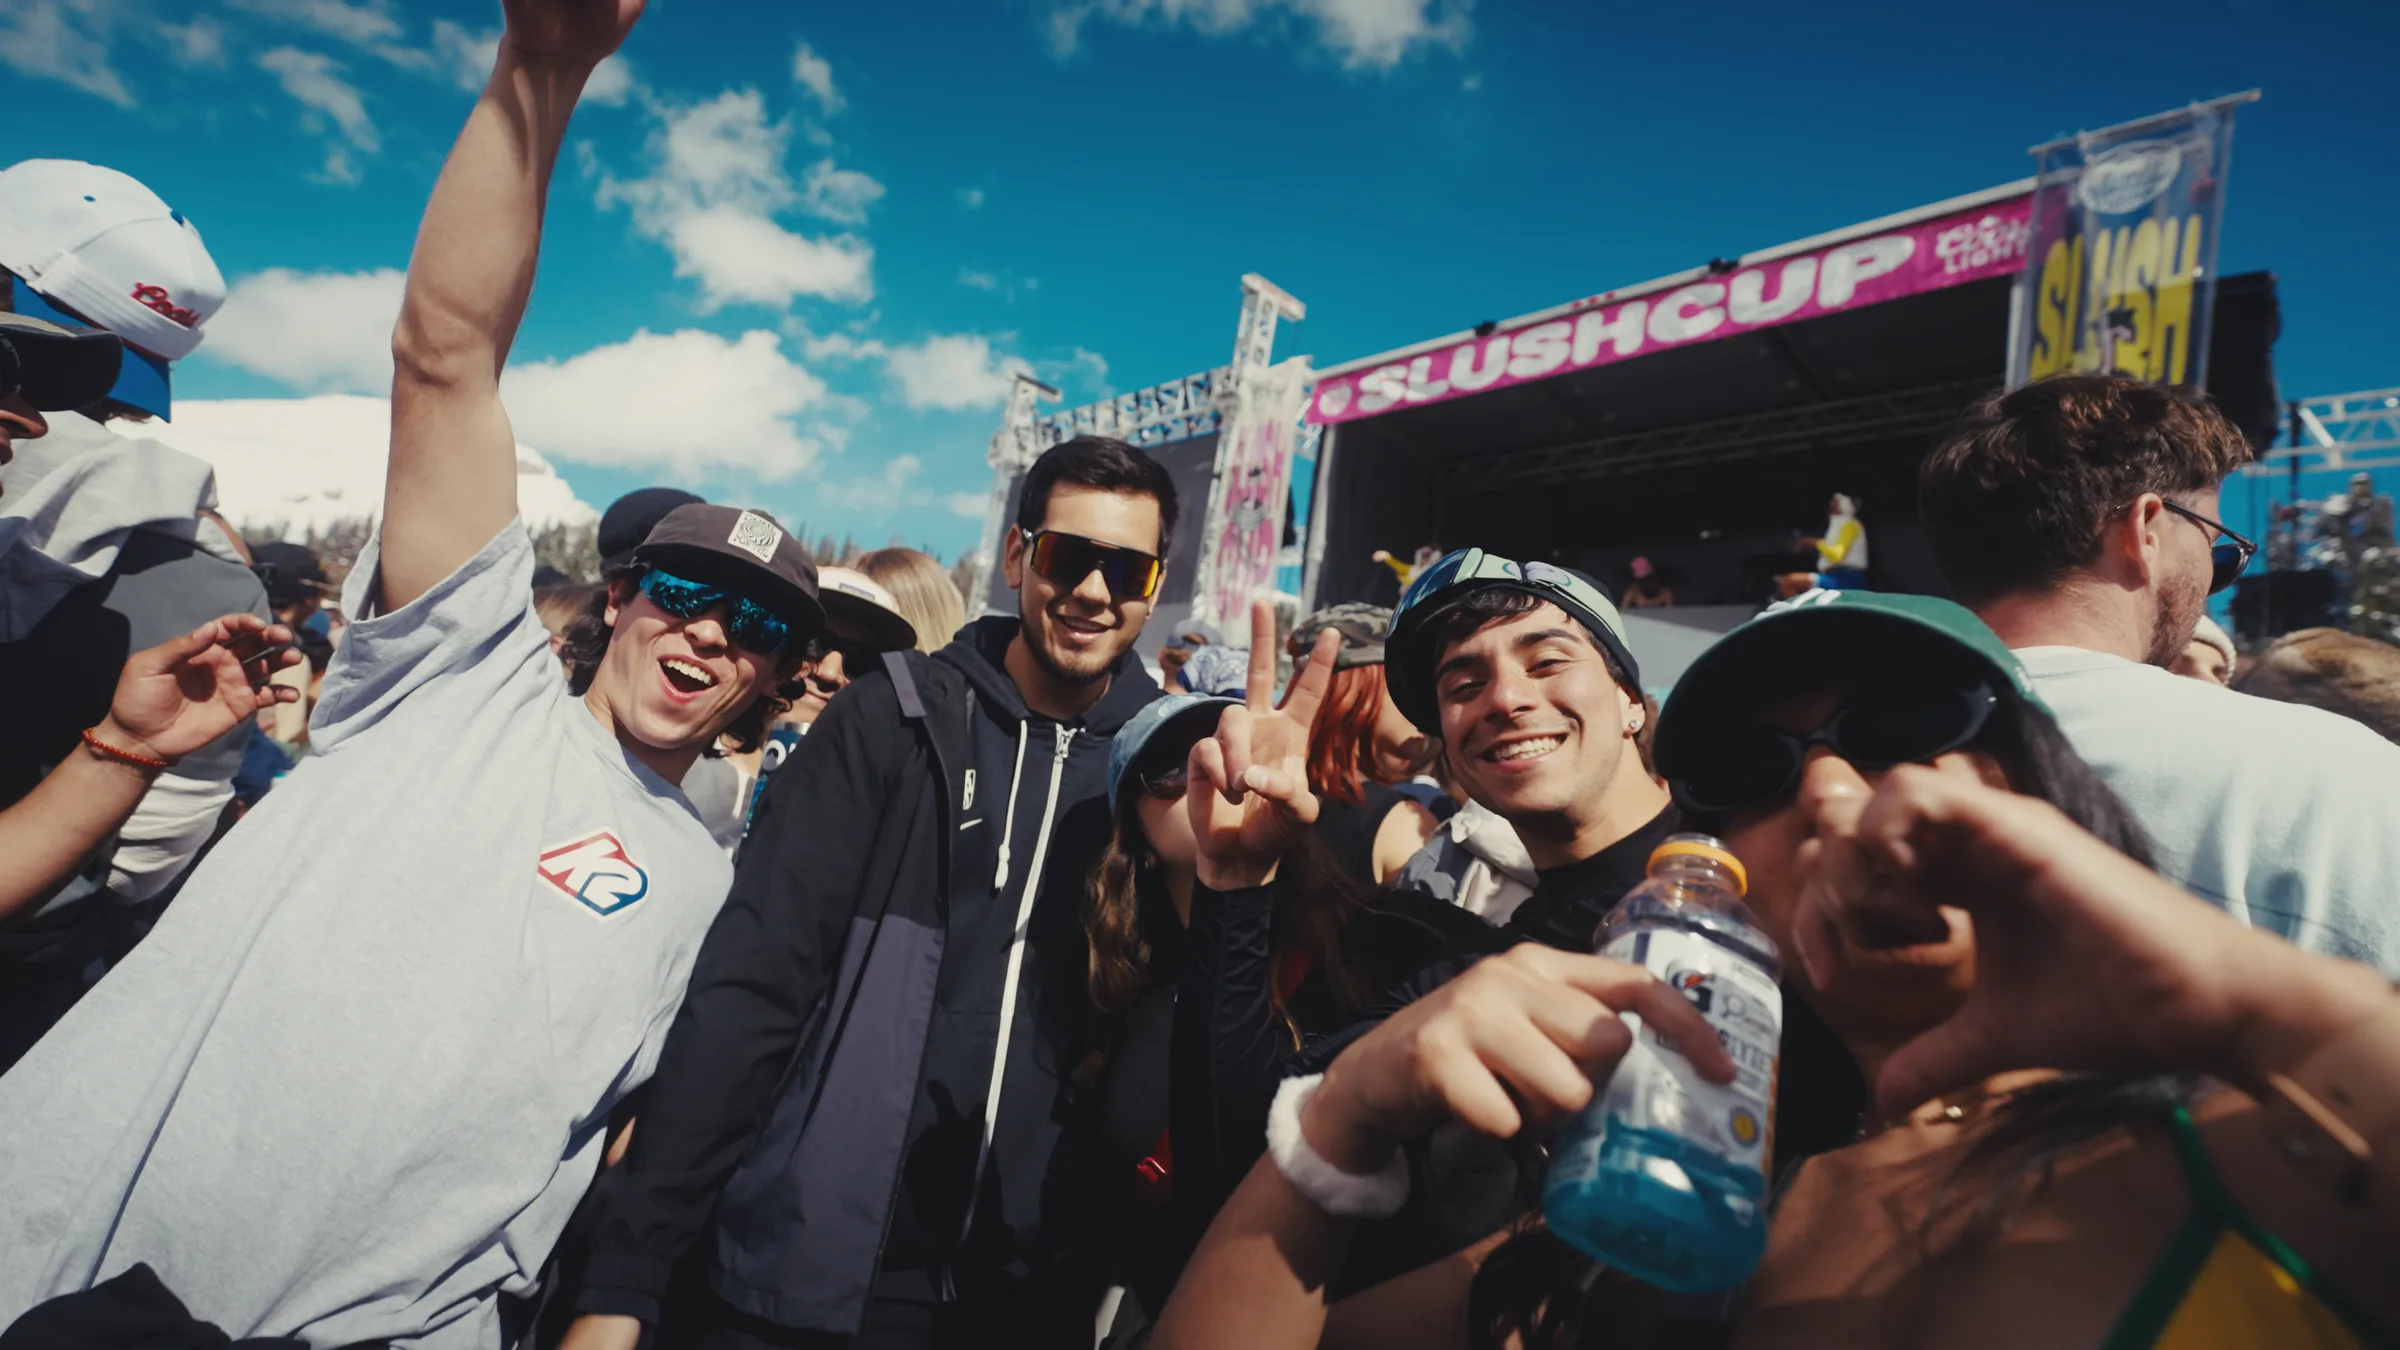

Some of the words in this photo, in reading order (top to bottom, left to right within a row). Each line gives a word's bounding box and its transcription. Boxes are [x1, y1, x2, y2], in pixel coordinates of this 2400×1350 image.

[1356, 234, 1916, 412] SLUSHCUP
[2029, 213, 2202, 387] SLUSH
[538, 832, 649, 917] K2
